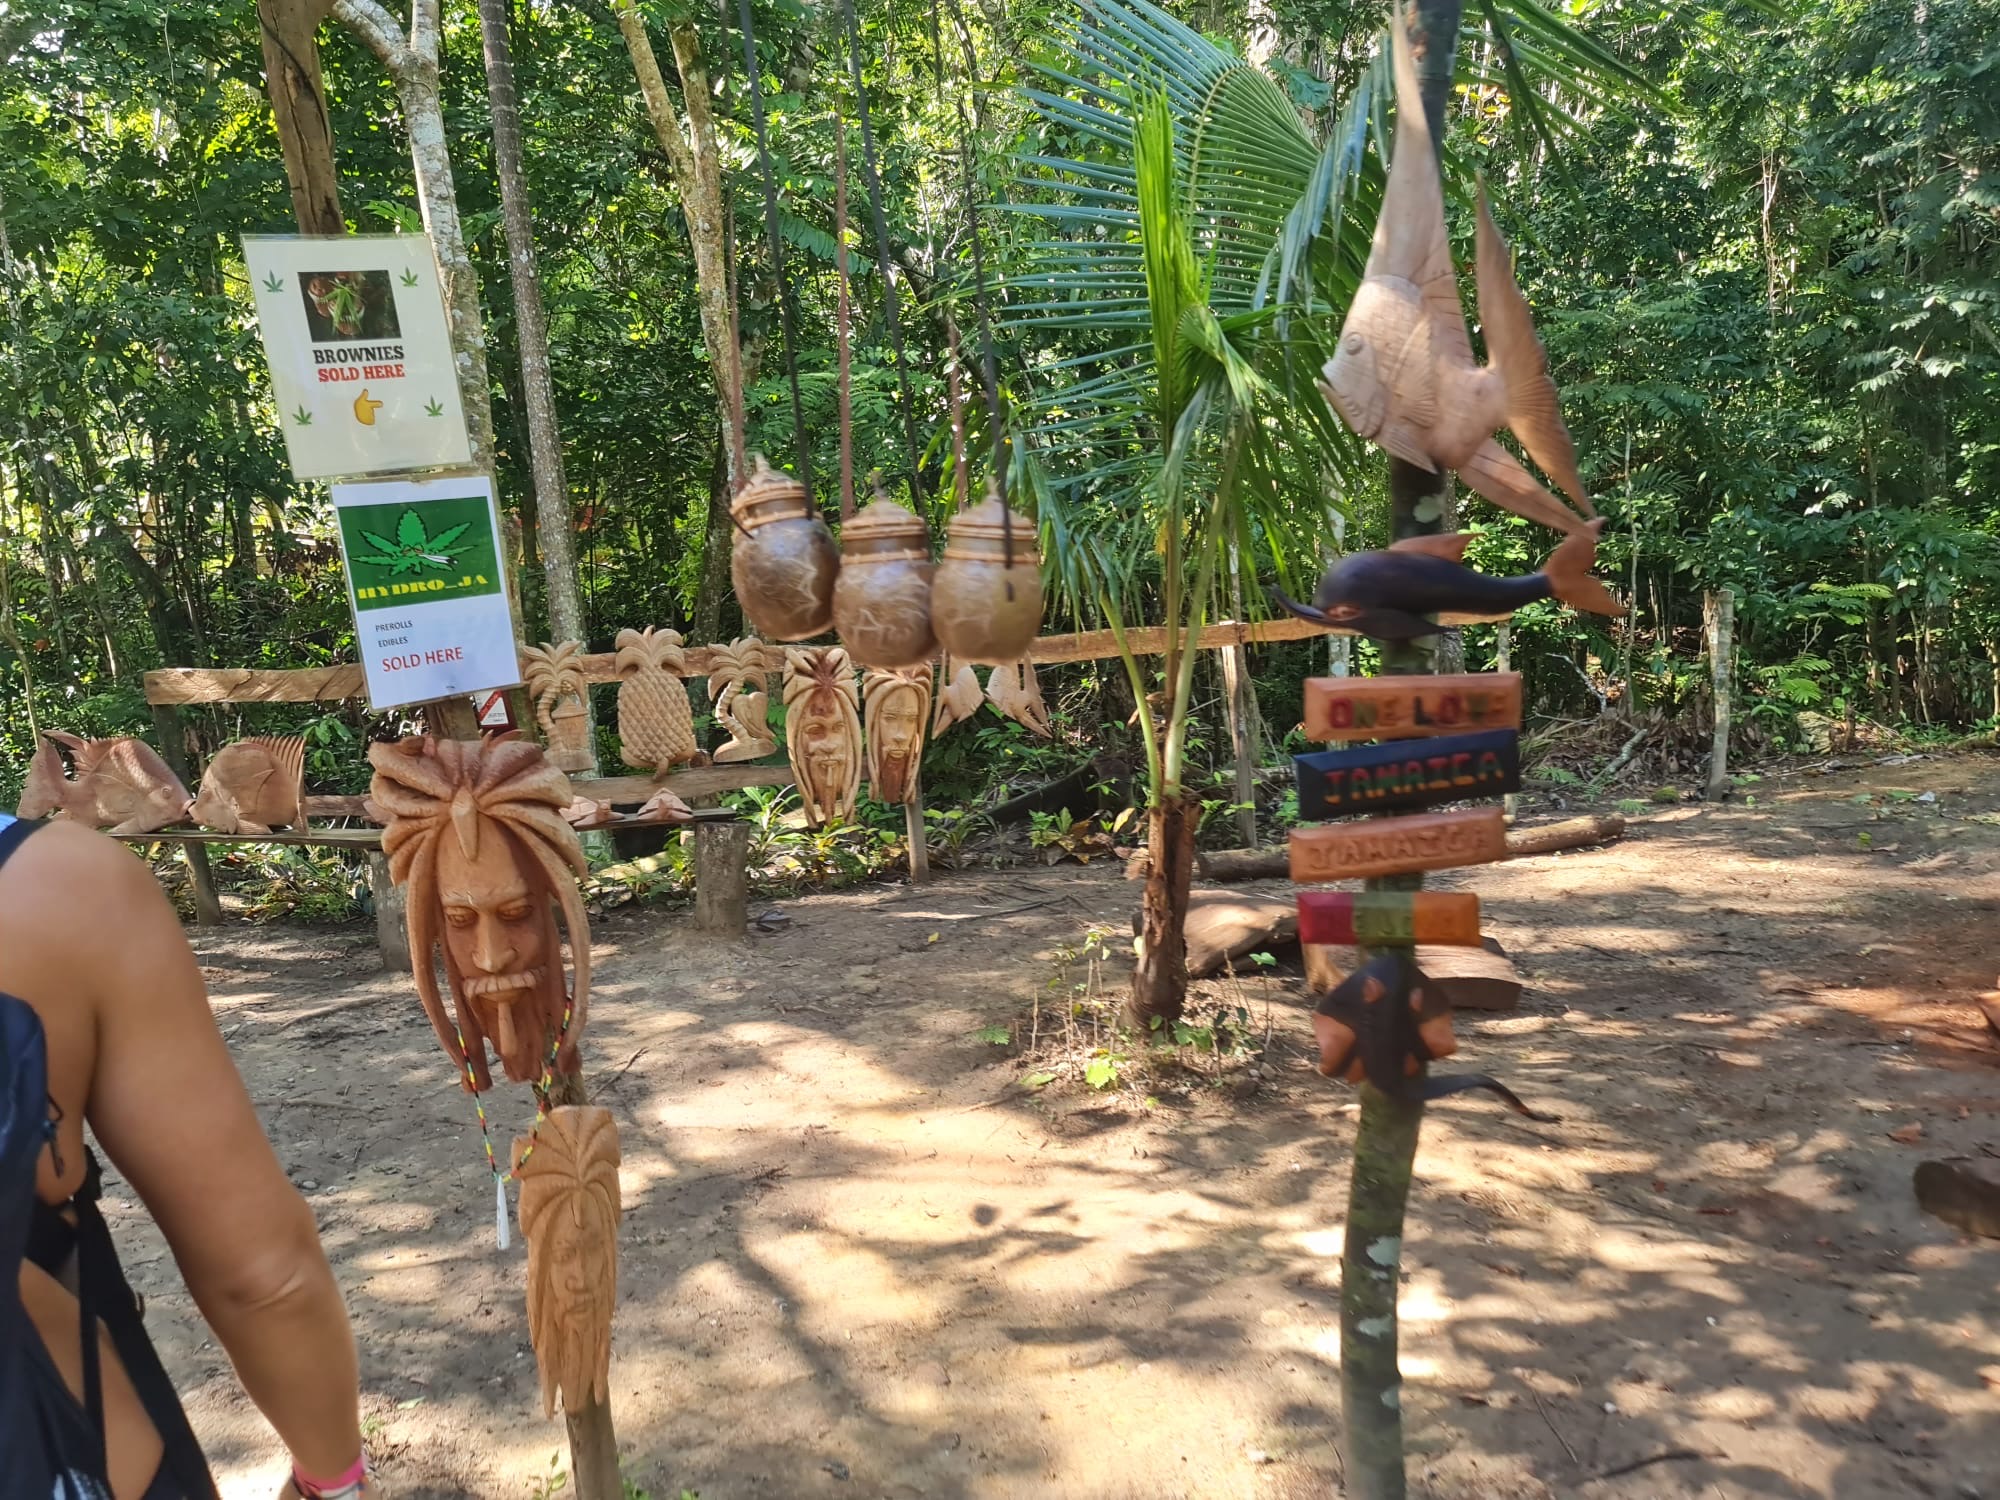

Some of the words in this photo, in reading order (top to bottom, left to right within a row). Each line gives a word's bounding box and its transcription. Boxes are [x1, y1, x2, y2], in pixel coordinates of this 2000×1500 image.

[313, 346, 404, 363] BROWNIES
[318, 368, 359, 382] SOLD
[363, 364, 404, 379] HERE
[375, 619, 413, 633] PREROLLS
[378, 635, 408, 648] EDIBLES
[382, 653, 421, 672] SOLD
[425, 647, 464, 665] HERE
